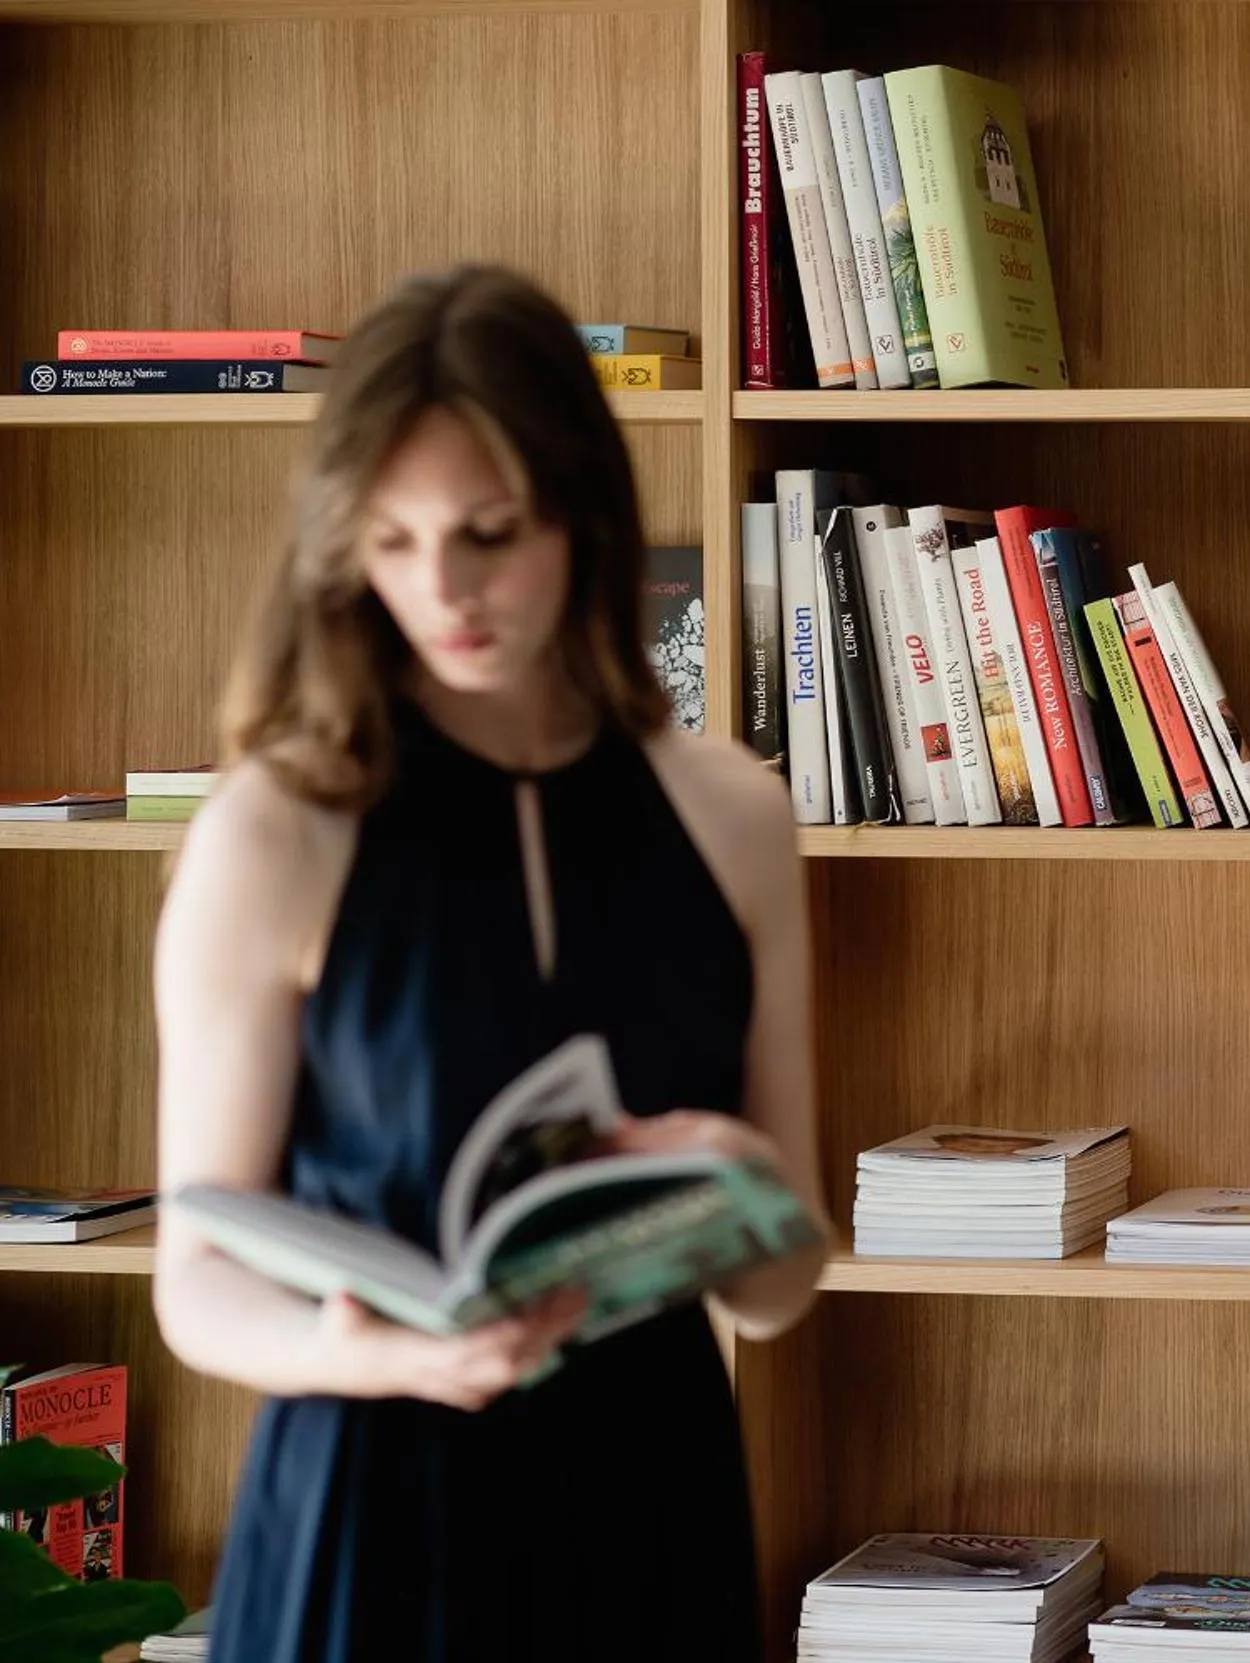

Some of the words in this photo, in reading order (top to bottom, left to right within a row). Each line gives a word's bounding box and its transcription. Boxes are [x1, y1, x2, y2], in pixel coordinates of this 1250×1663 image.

[743, 87, 763, 214] Brauchtum
[61, 379, 70, 387] A
[71, 379, 108, 388] Monocle
[109, 379, 136, 388] Guide
[62, 369, 84, 379] How
[86, 370, 95, 379] to
[97, 369, 122, 380] Make
[965, 568, 987, 611] Road
[793, 606, 815, 703] Trachten
[843, 613, 858, 658] LEINEN
[974, 617, 993, 645] the
[905, 634, 934, 684] VELO
[980, 649, 1000, 679] Hit
[1027, 620, 1060, 713] ROMANCE
[1058, 634, 1082, 697] Architektur
[754, 649, 767, 732] Wanderlust
[946, 659, 977, 768] EVERGREEN
[1170, 653, 1183, 673] MIES
[1178, 674, 1191, 692] VAN
[1186, 693, 1199, 712] DER
[1193, 713, 1208, 739] ROHE
[1052, 725, 1067, 751] New
[21, 1383, 112, 1423] MONOCLE
